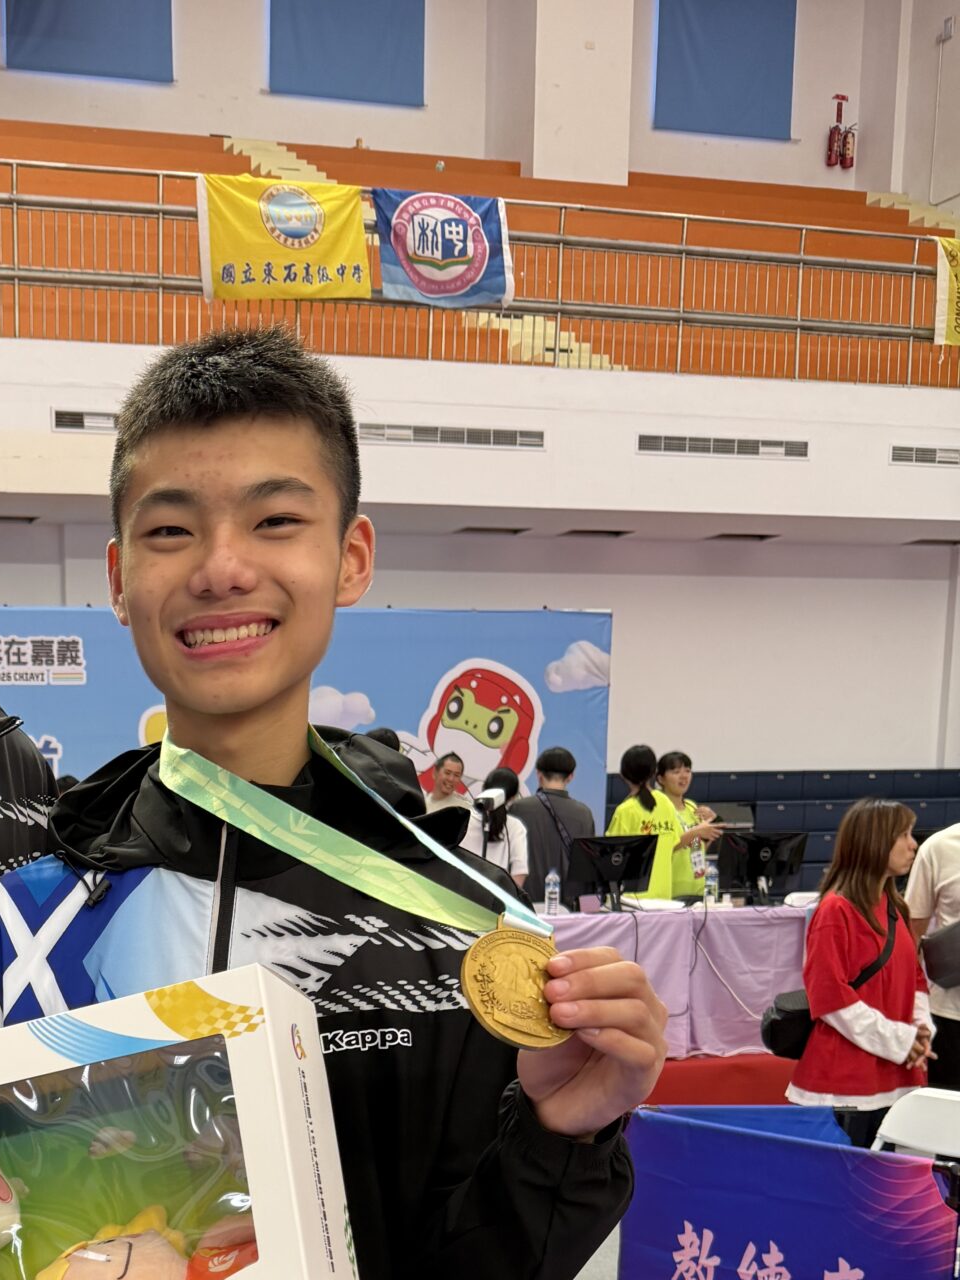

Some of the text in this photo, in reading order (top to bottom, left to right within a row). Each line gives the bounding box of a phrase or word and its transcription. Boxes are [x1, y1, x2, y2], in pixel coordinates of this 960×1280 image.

[221, 261, 363, 285] 國立東石高級中學
[13, 672, 45, 682] CHIAYI
[320, 1028, 413, 1054] Kappa
